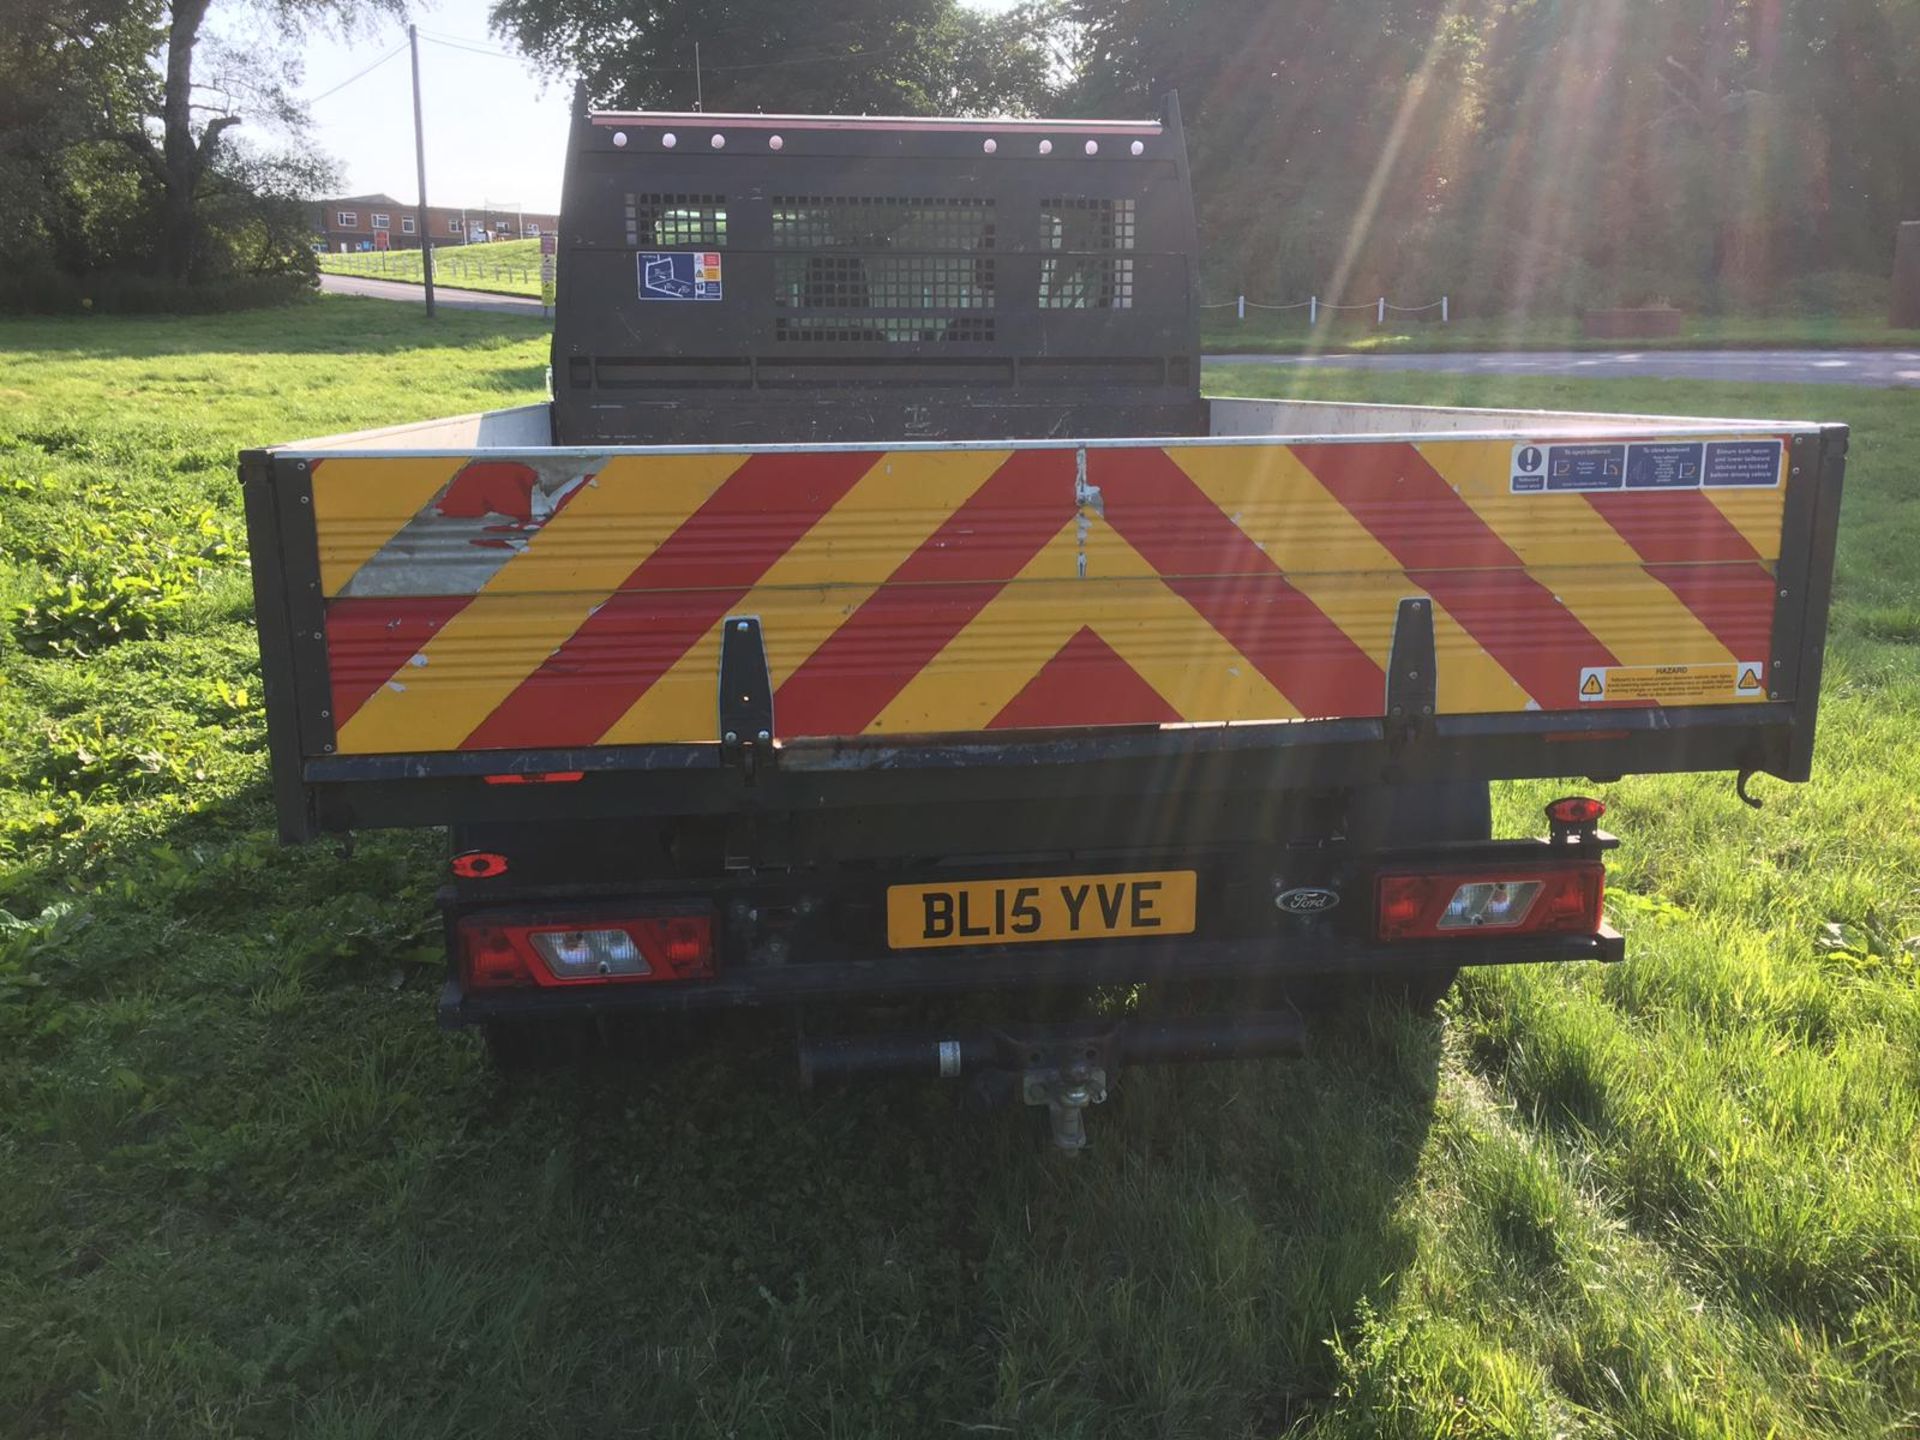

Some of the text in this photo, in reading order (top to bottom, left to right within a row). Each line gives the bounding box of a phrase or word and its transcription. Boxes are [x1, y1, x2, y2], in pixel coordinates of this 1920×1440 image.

[1656, 666, 1688, 674] HAZARD
[1289, 892, 1328, 909] Ford
[922, 881, 1163, 940] BL15 YVE
